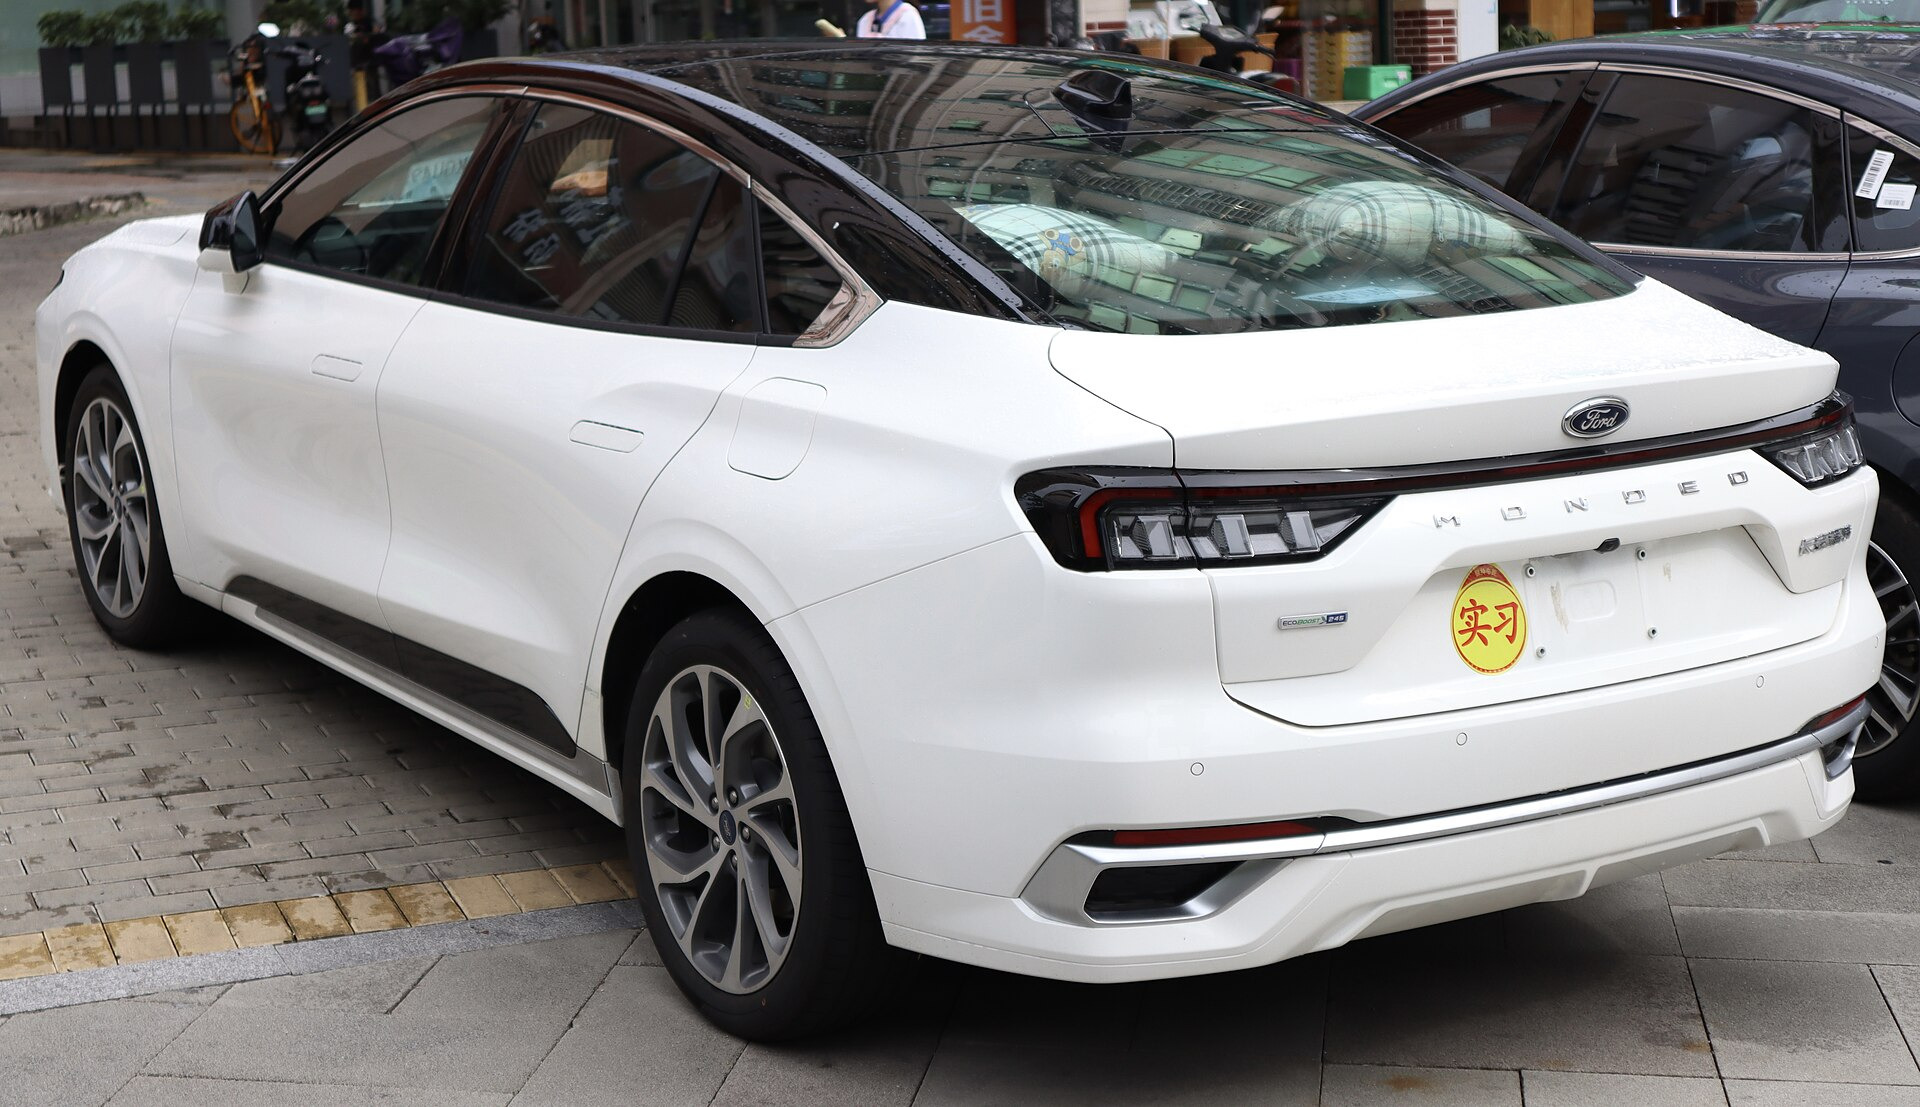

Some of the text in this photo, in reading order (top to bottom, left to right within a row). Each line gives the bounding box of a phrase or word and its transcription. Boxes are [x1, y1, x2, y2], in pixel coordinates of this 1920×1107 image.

[1581, 408, 1619, 430] Ford
[1433, 471, 1749, 529] MONDEO
[1282, 615, 1345, 626] ECOBOOST 245
[1458, 599, 1519, 647] 实习
